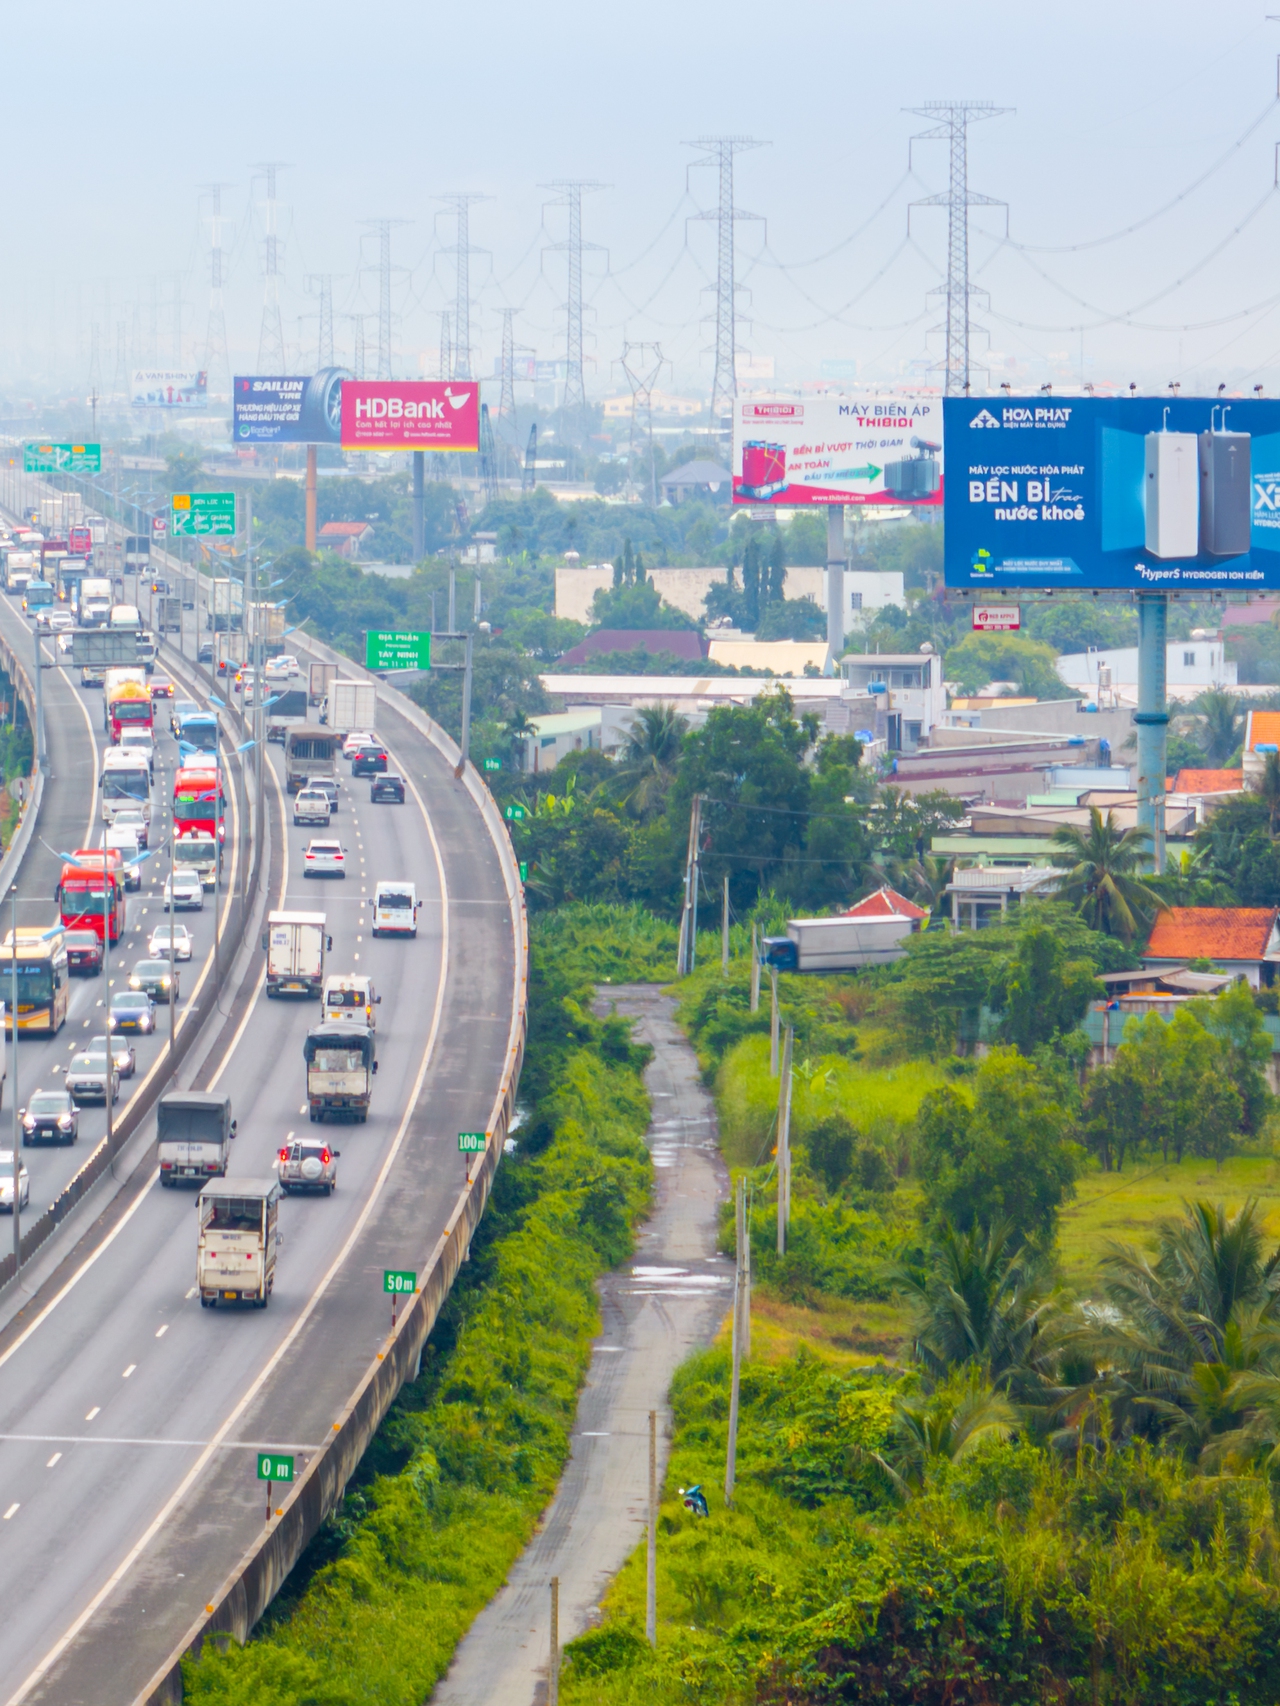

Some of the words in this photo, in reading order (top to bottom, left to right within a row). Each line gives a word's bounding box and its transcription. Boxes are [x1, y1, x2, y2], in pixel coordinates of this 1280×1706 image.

[253, 381, 303, 391] SAILUN
[356, 398, 444, 418] HDBank
[840, 402, 869, 415] MÁY
[875, 402, 906, 416] BIẾN
[912, 403, 930, 416] ÁP
[857, 417, 913, 427] THIBIDI
[827, 442, 853, 452] VƯỢT
[856, 439, 877, 450] THỜI
[880, 438, 904, 447] GIAN
[804, 460, 830, 469] TOÀN
[969, 464, 988, 474] MÁY
[991, 466, 1009, 476] LỌC
[1012, 464, 1038, 474] NƯỚC
[1040, 464, 1059, 474] HÒA
[1062, 464, 1084, 474] PHÁT
[995, 505, 1038, 520] nước
[1042, 504, 1085, 520] khoẻ
[1142, 568, 1180, 581] HyperS
[1183, 571, 1227, 579] HYDROGEN
[1229, 571, 1244, 579] ION
[388, 1275, 412, 1291] 50m
[262, 1458, 271, 1476] 0
[277, 1464, 288, 1477] m
